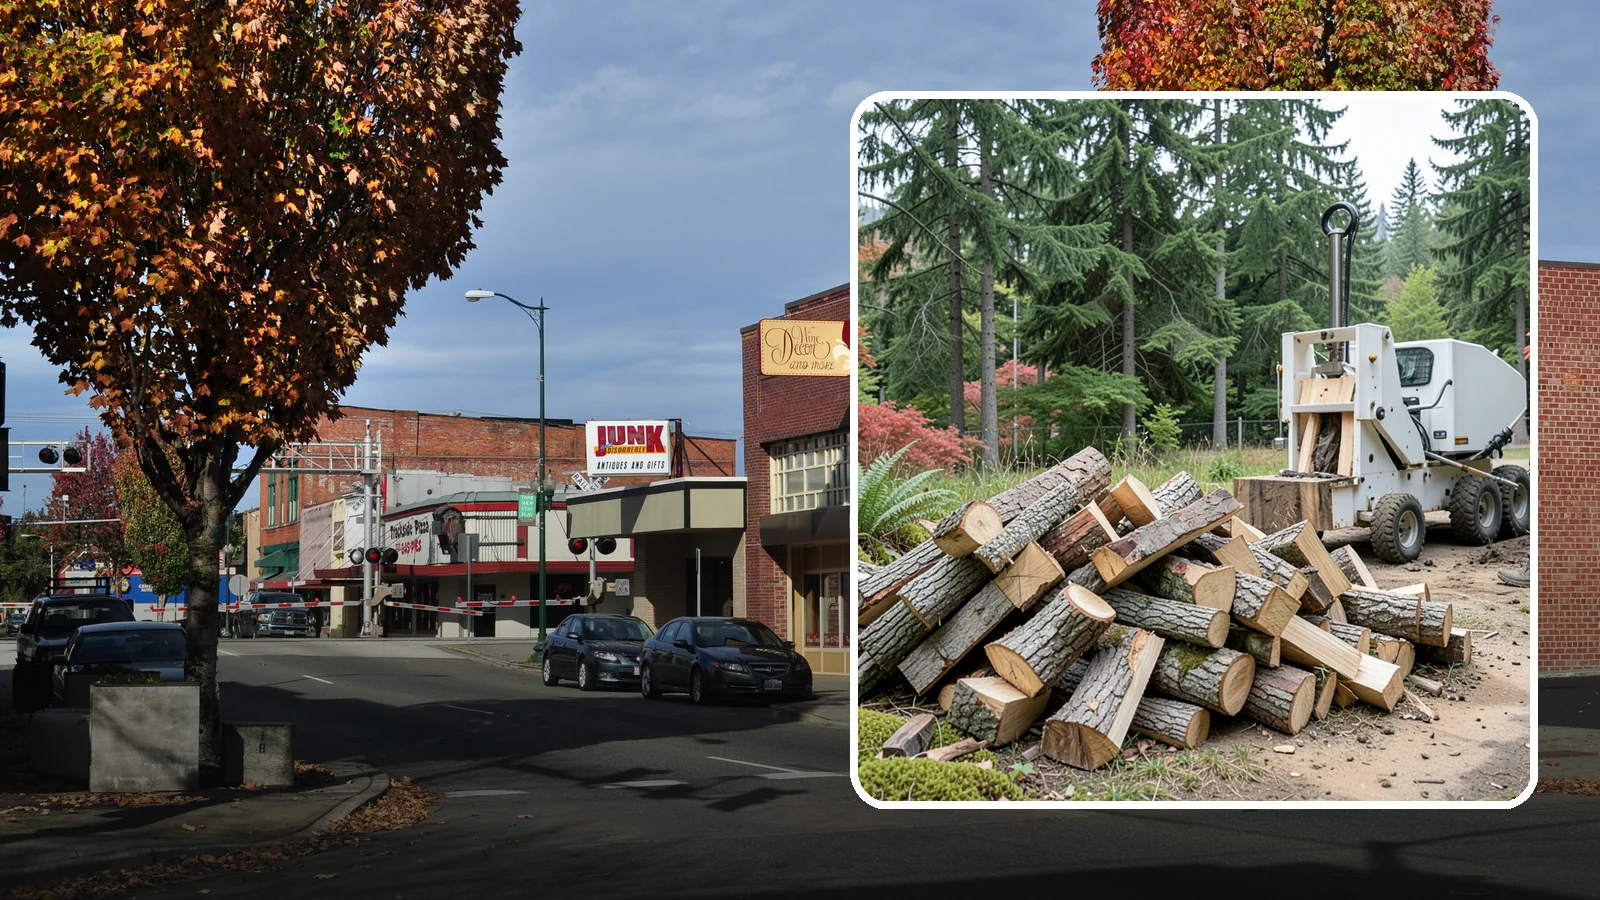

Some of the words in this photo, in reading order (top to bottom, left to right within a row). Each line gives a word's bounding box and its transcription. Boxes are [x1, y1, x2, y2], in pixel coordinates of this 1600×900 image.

[595, 425, 665, 457] JUNK
[607, 446, 646, 454] DISORDERLY
[597, 461, 628, 470] ANTIQUES
[631, 461, 643, 470] AND
[647, 460, 665, 469] GIFTS
[390, 521, 413, 540] Trackside
[414, 519, 429, 535] Pizza
